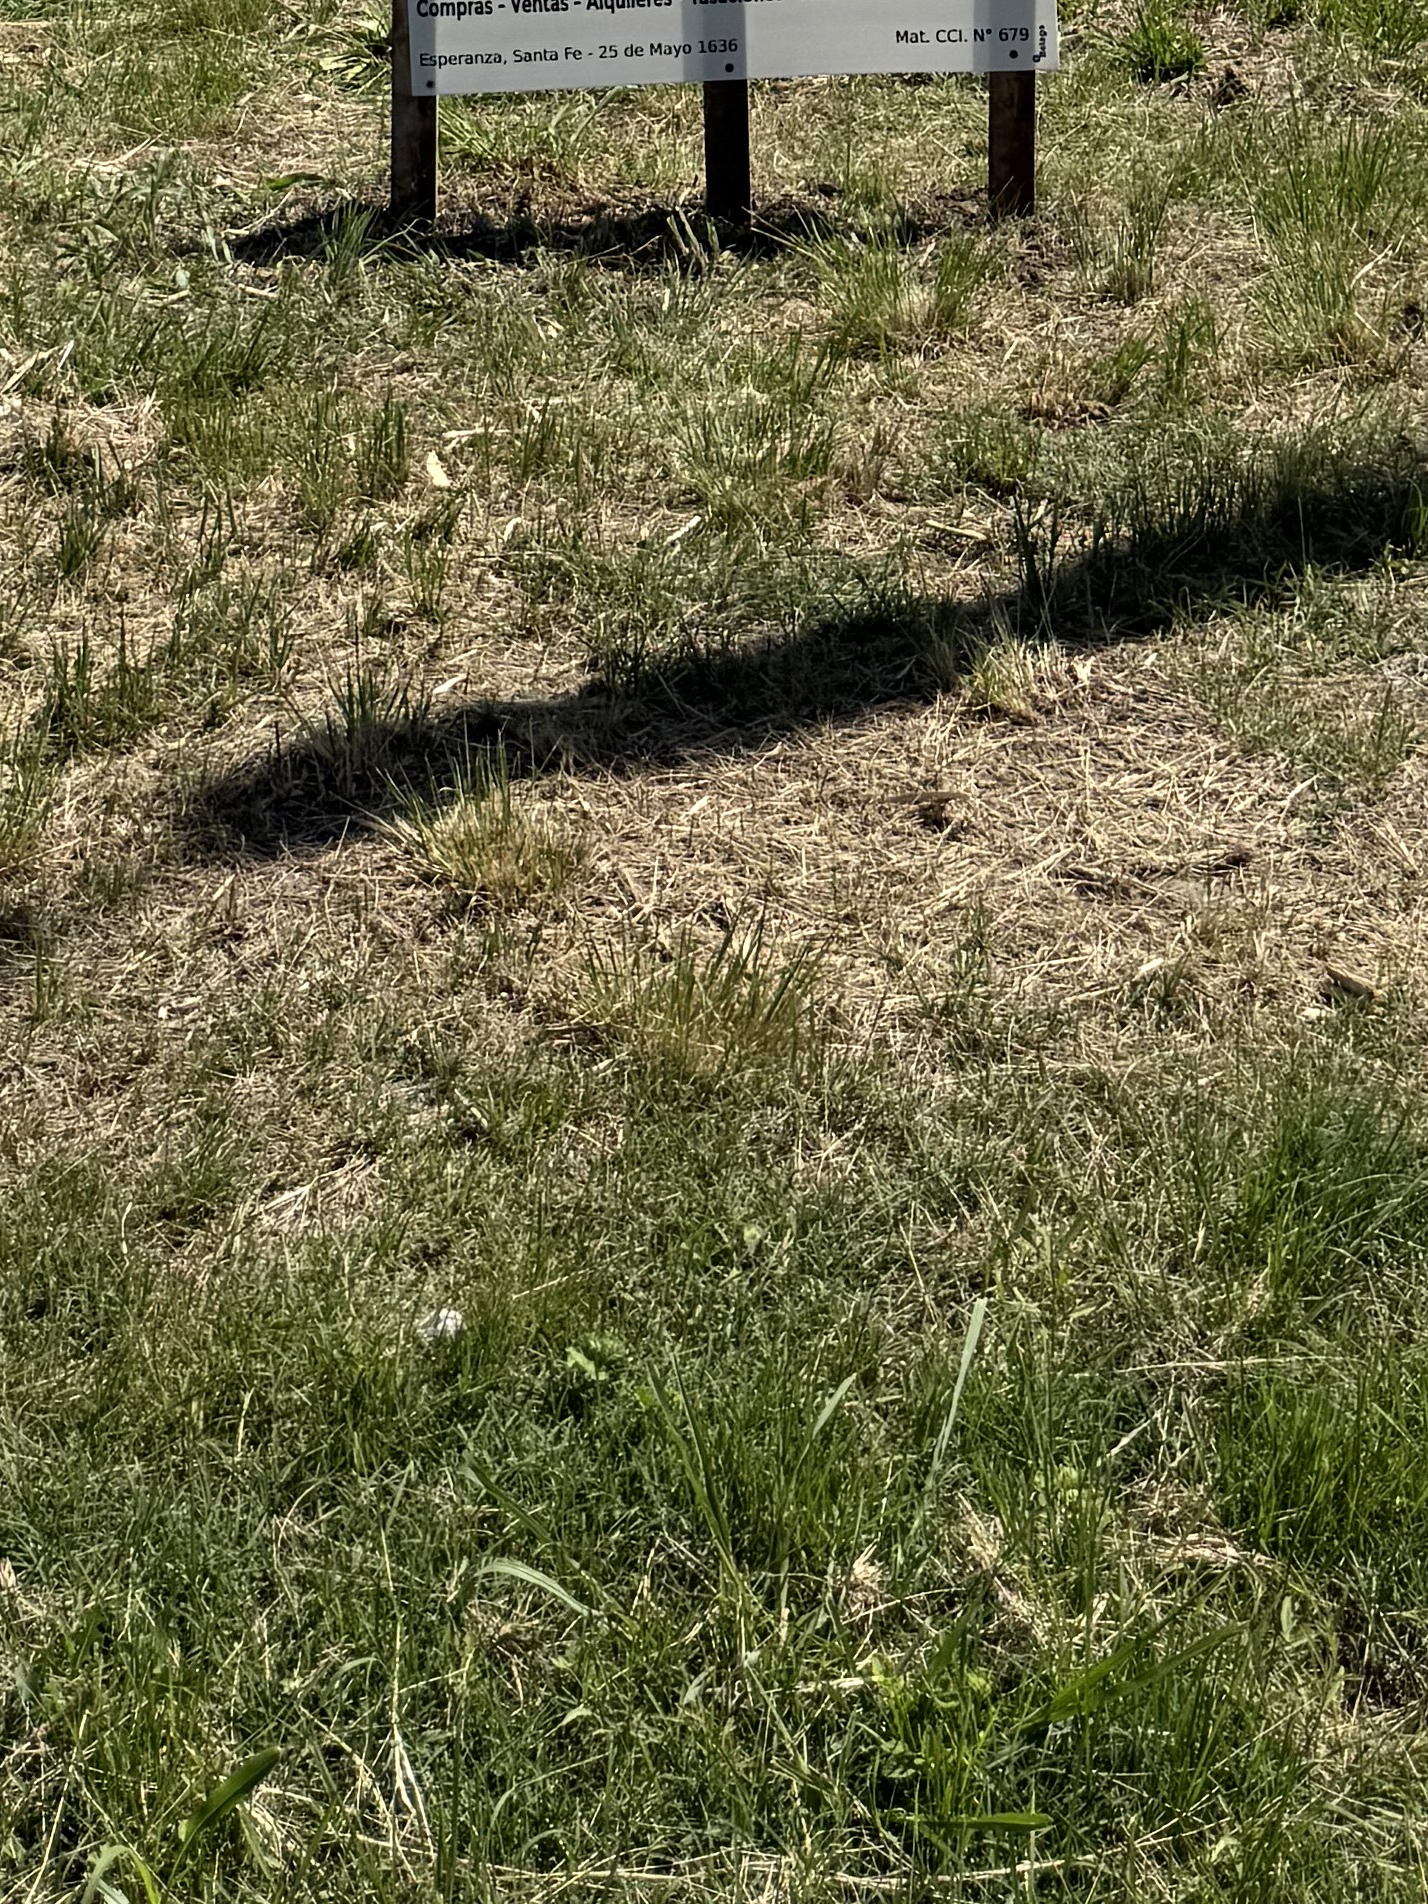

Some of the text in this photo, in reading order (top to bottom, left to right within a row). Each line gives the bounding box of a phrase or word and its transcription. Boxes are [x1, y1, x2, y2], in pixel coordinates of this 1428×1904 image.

[895, 30, 930, 43] Mat.
[998, 27, 1029, 42] 679
[419, 51, 508, 69] Esperanza,
[512, 48, 559, 63] Santa
[564, 46, 582, 60] Fe
[598, 45, 618, 59] 25
[623, 43, 645, 58] de
[649, 42, 692, 58] Mayo
[698, 38, 738, 53] 1636
